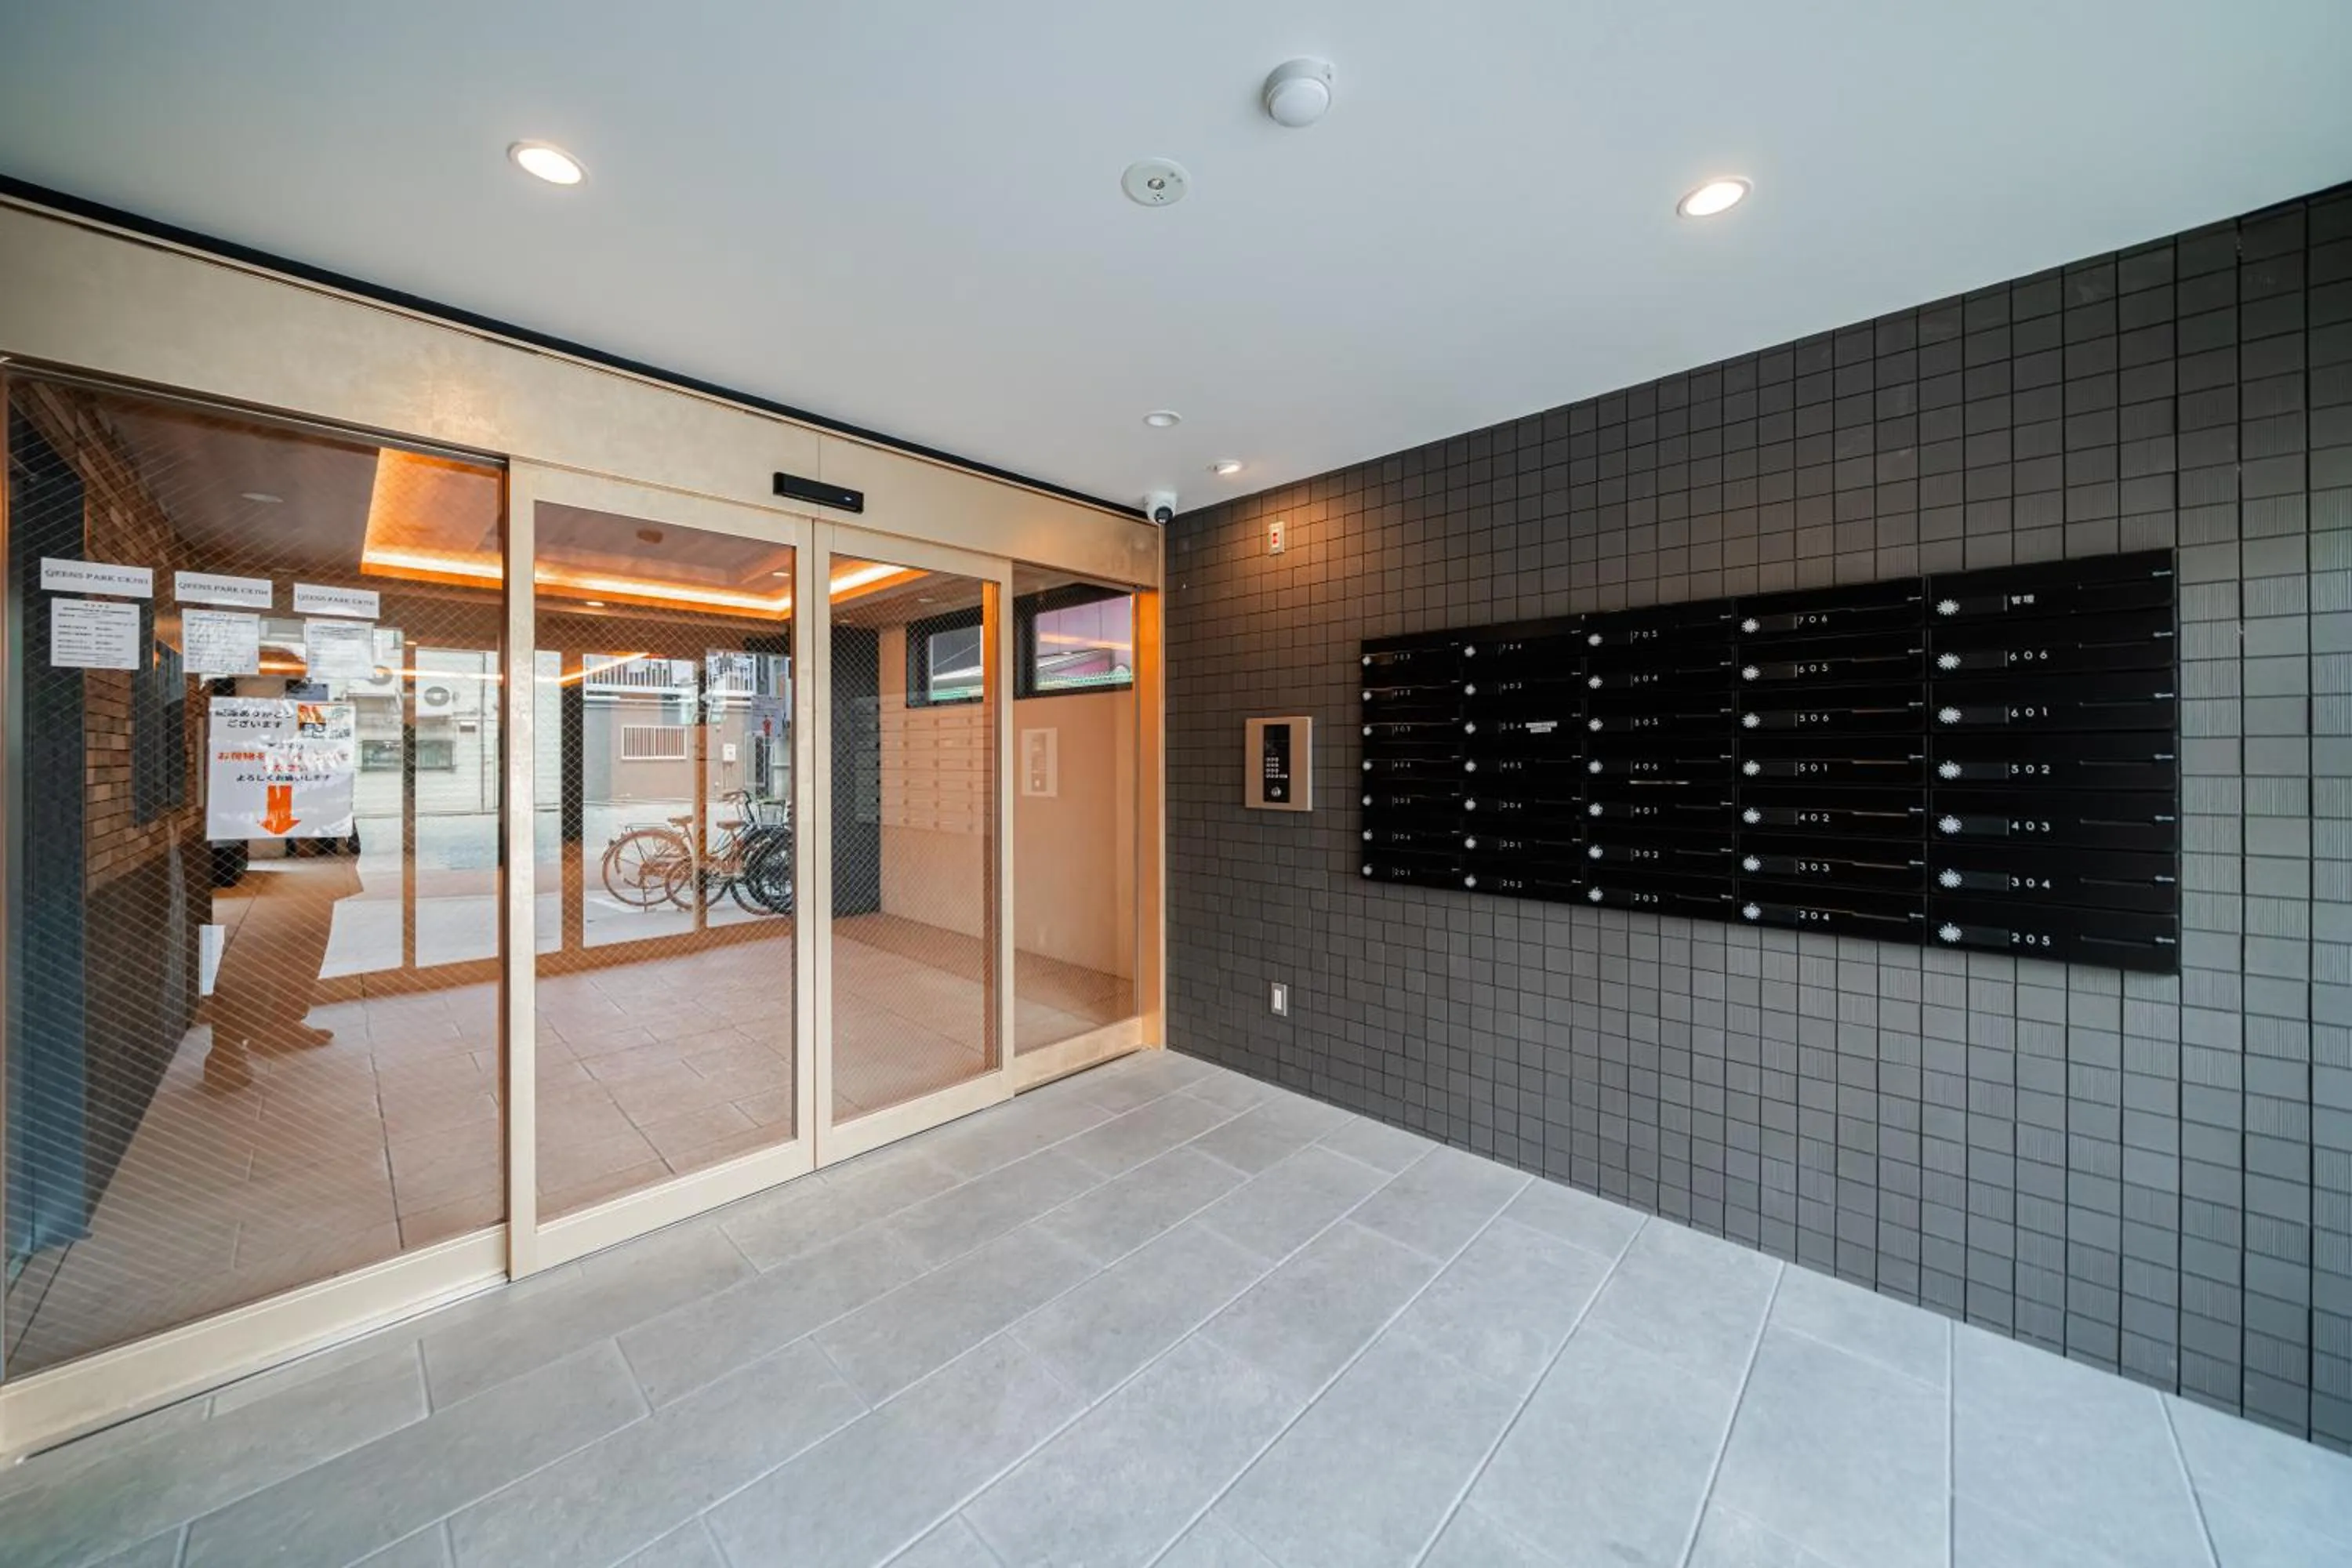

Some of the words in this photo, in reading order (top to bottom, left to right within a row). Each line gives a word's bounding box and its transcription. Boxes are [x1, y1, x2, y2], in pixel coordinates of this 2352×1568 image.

[86, 573, 114, 583] PARK
[214, 585, 239, 593] PARK
[1798, 614, 1827, 624] 706
[1634, 630, 1657, 638] 705
[2009, 650, 2047, 661] 606
[1798, 662, 1828, 673] 605
[2010, 706, 2047, 717] 601
[227, 720, 283, 729] ございます
[1635, 717, 1657, 726] 505
[1799, 763, 1827, 771] 501
[2011, 764, 2049, 774] 502
[236, 773, 331, 782] よろしくお願いします
[1799, 813, 1829, 822] 402
[2011, 821, 2049, 831] 403
[1635, 849, 1657, 858] 302
[1799, 862, 1829, 872] 303
[2011, 877, 2049, 888] 304
[1635, 893, 1657, 902] 203
[1799, 910, 1829, 920] 204
[2012, 932, 2049, 946] 205
